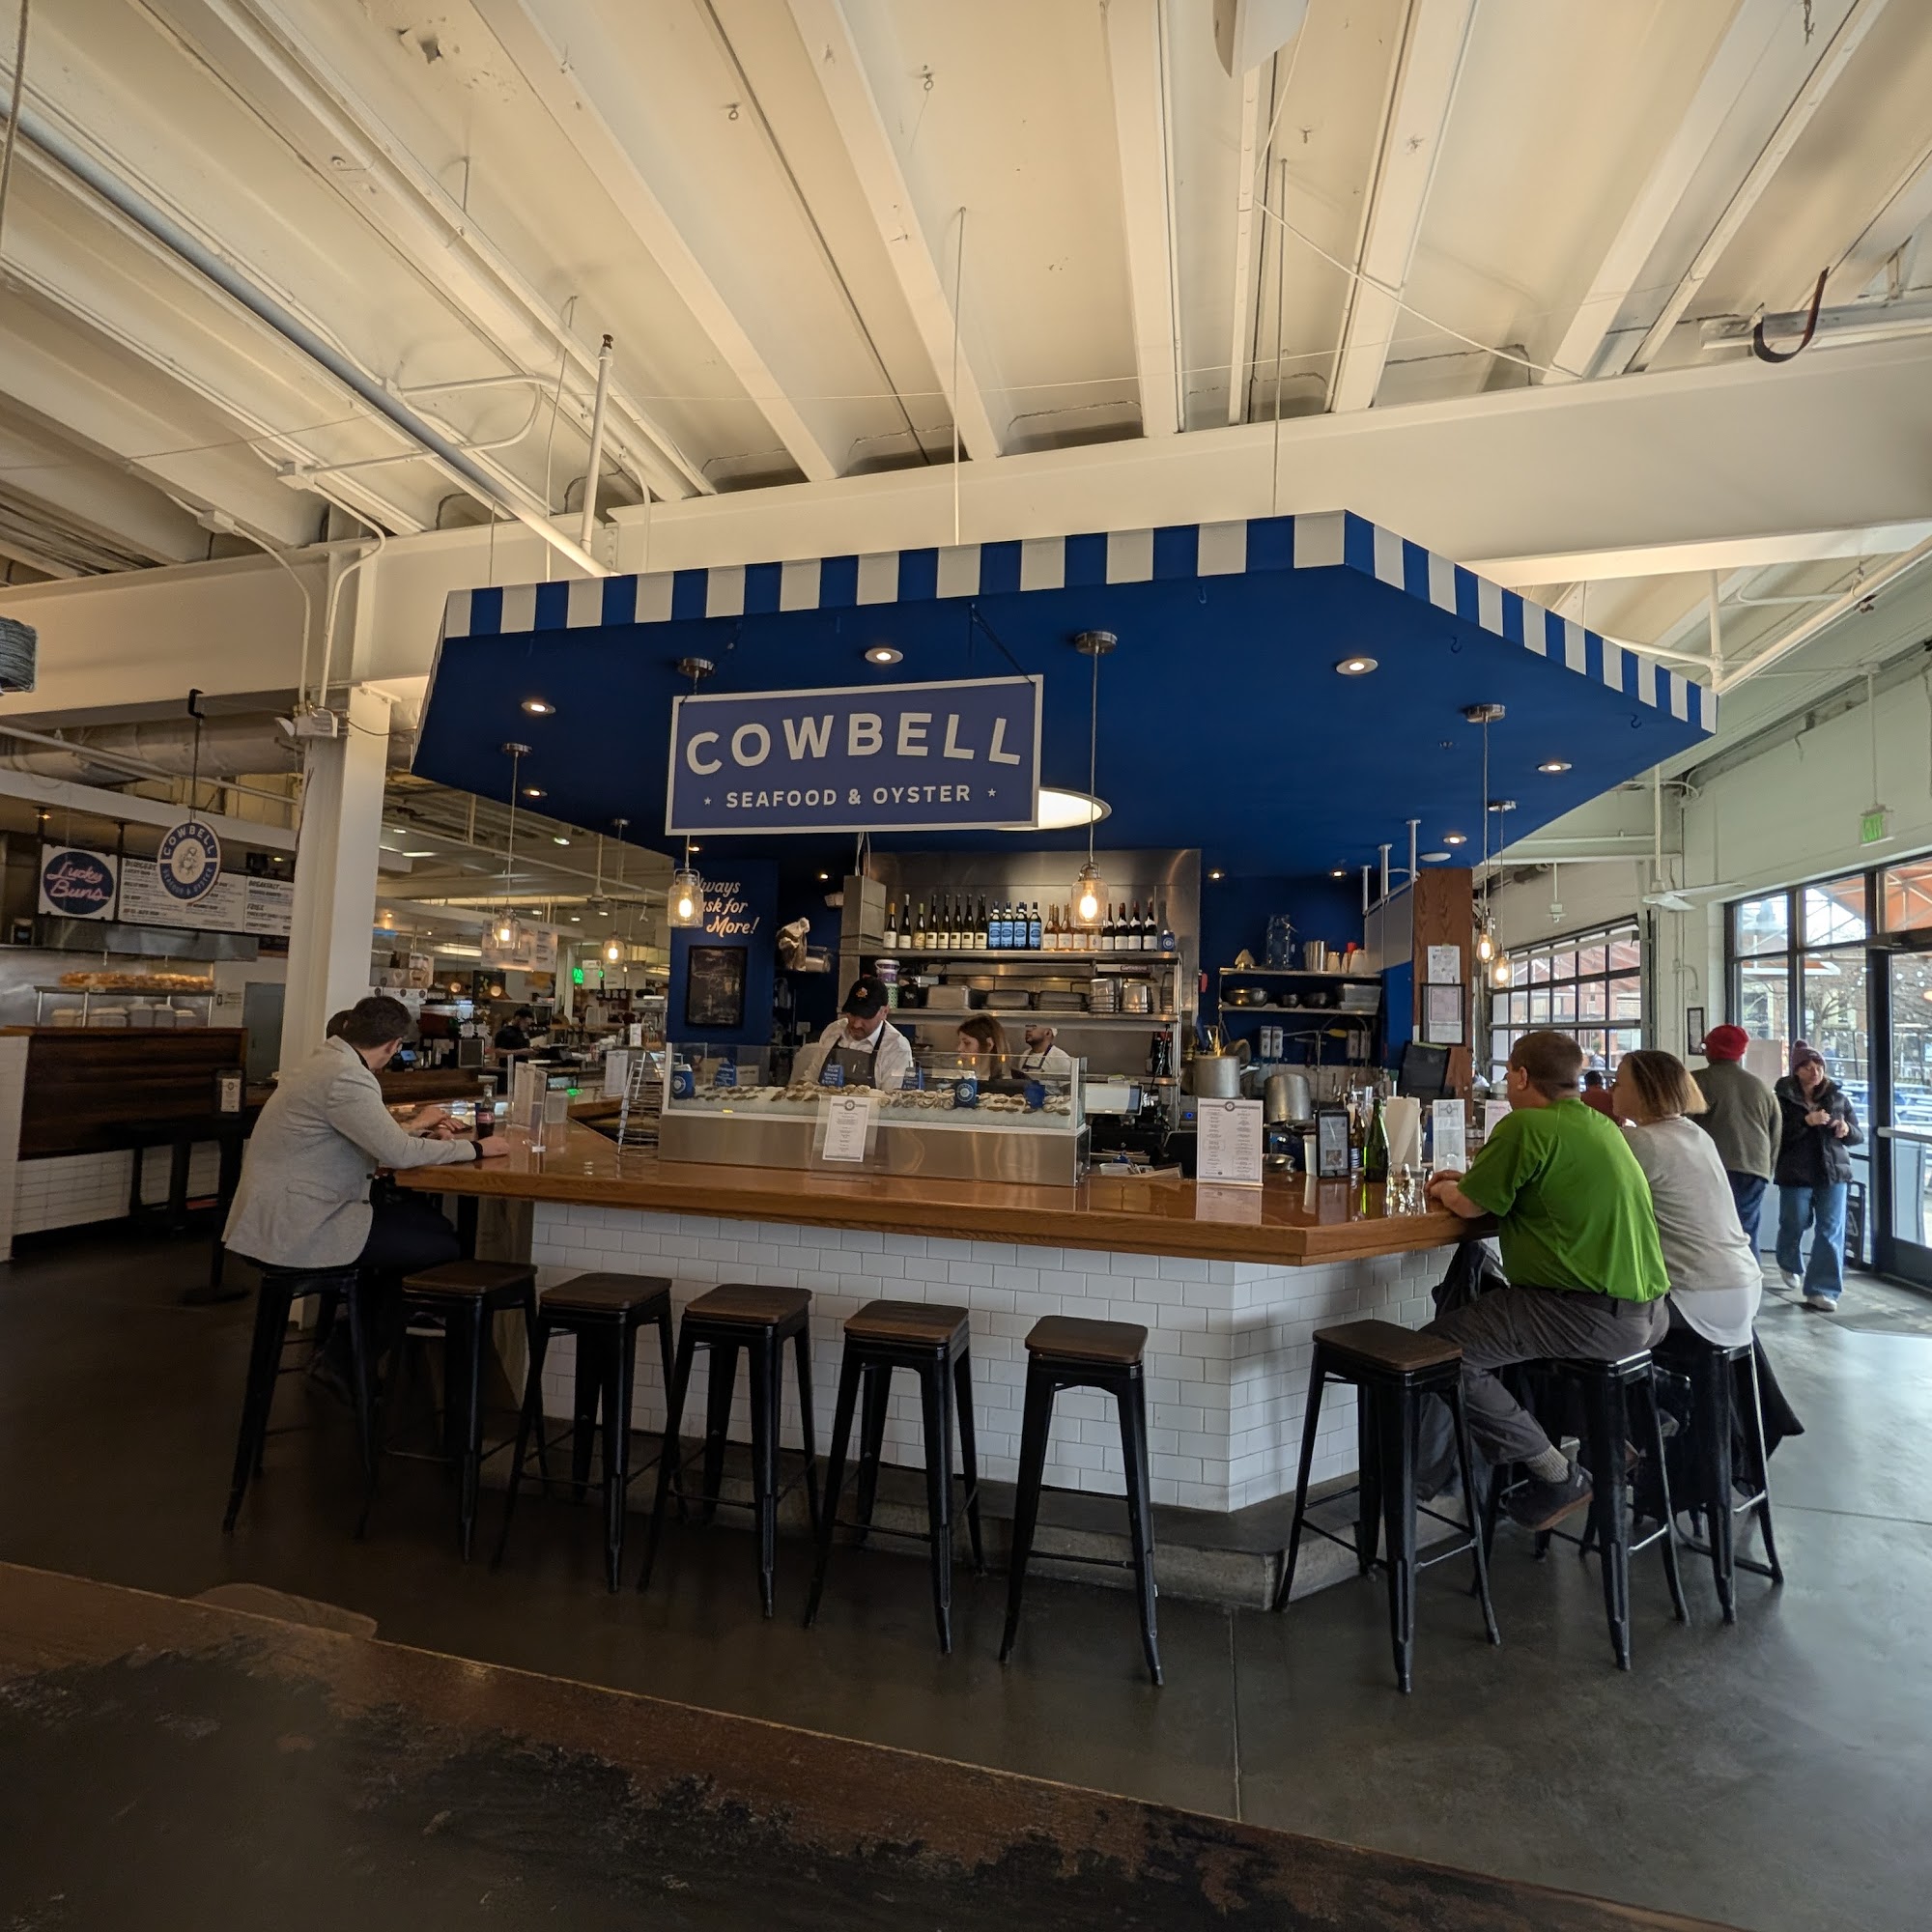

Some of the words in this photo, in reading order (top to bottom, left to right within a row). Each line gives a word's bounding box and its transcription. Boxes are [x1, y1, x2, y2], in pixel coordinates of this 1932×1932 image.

[686, 712, 1021, 776] COWBELL
[725, 788, 838, 809] SEAFOOD
[847, 787, 862, 805] &
[872, 784, 971, 804] OYSTER
[163, 825, 214, 856] COWBELL
[46, 861, 103, 884] Lucky
[50, 880, 110, 901] Buns
[695, 877, 741, 897] lways
[722, 897, 749, 916] for
[706, 915, 760, 938] More!
